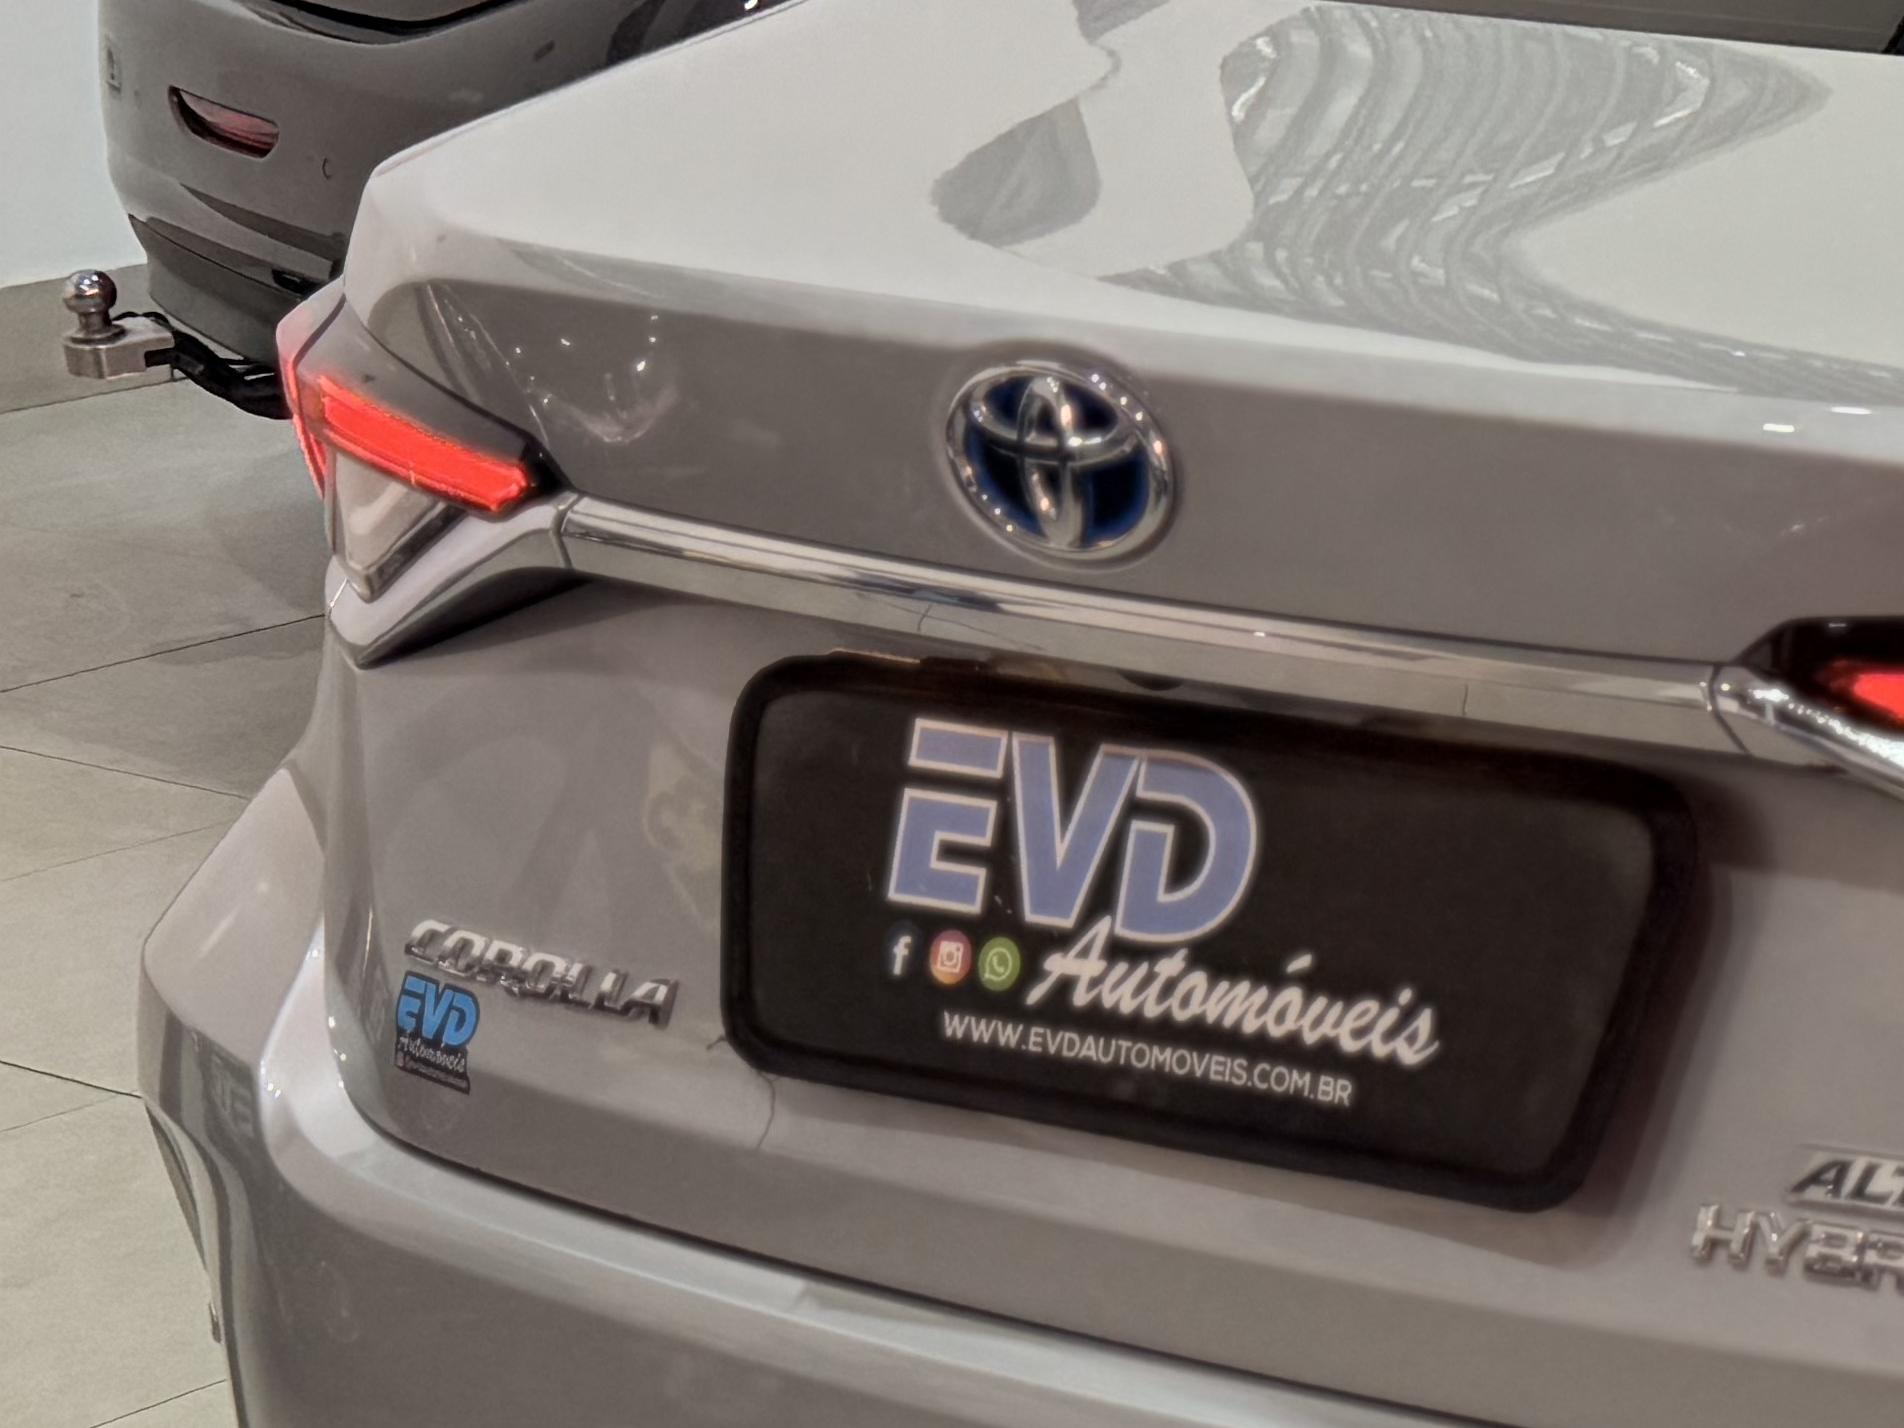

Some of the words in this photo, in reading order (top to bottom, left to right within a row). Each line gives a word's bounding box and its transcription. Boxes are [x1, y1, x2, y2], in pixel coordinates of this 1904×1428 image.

[888, 718, 1258, 943] EVD
[397, 974, 479, 1047] EVD
[404, 920, 679, 1028] COROLLA
[1026, 917, 1439, 1065] Automóveis
[943, 1011, 1353, 1107] WWW.EVDAUTOMOVEIS.COM.BR
